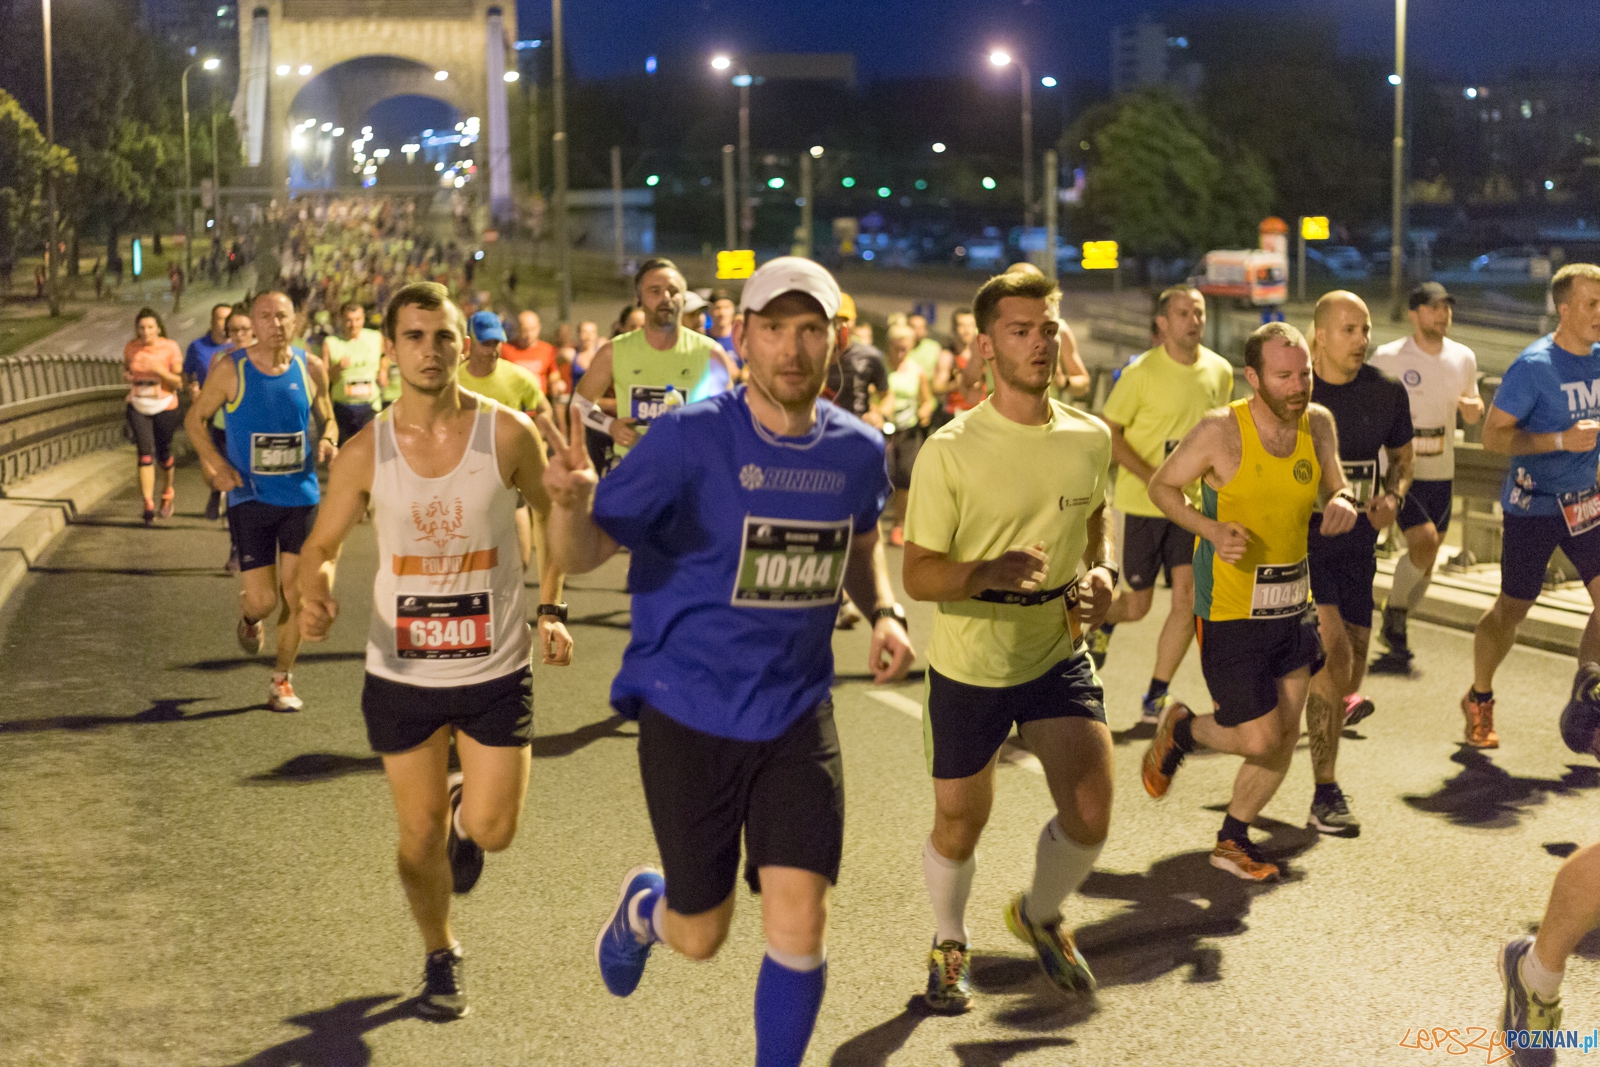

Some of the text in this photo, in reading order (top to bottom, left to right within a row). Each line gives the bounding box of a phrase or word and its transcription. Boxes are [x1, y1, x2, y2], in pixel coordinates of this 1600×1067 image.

[763, 467, 846, 494] RUNNING
[755, 553, 833, 588] 10144
[410, 619, 476, 647] 6340
